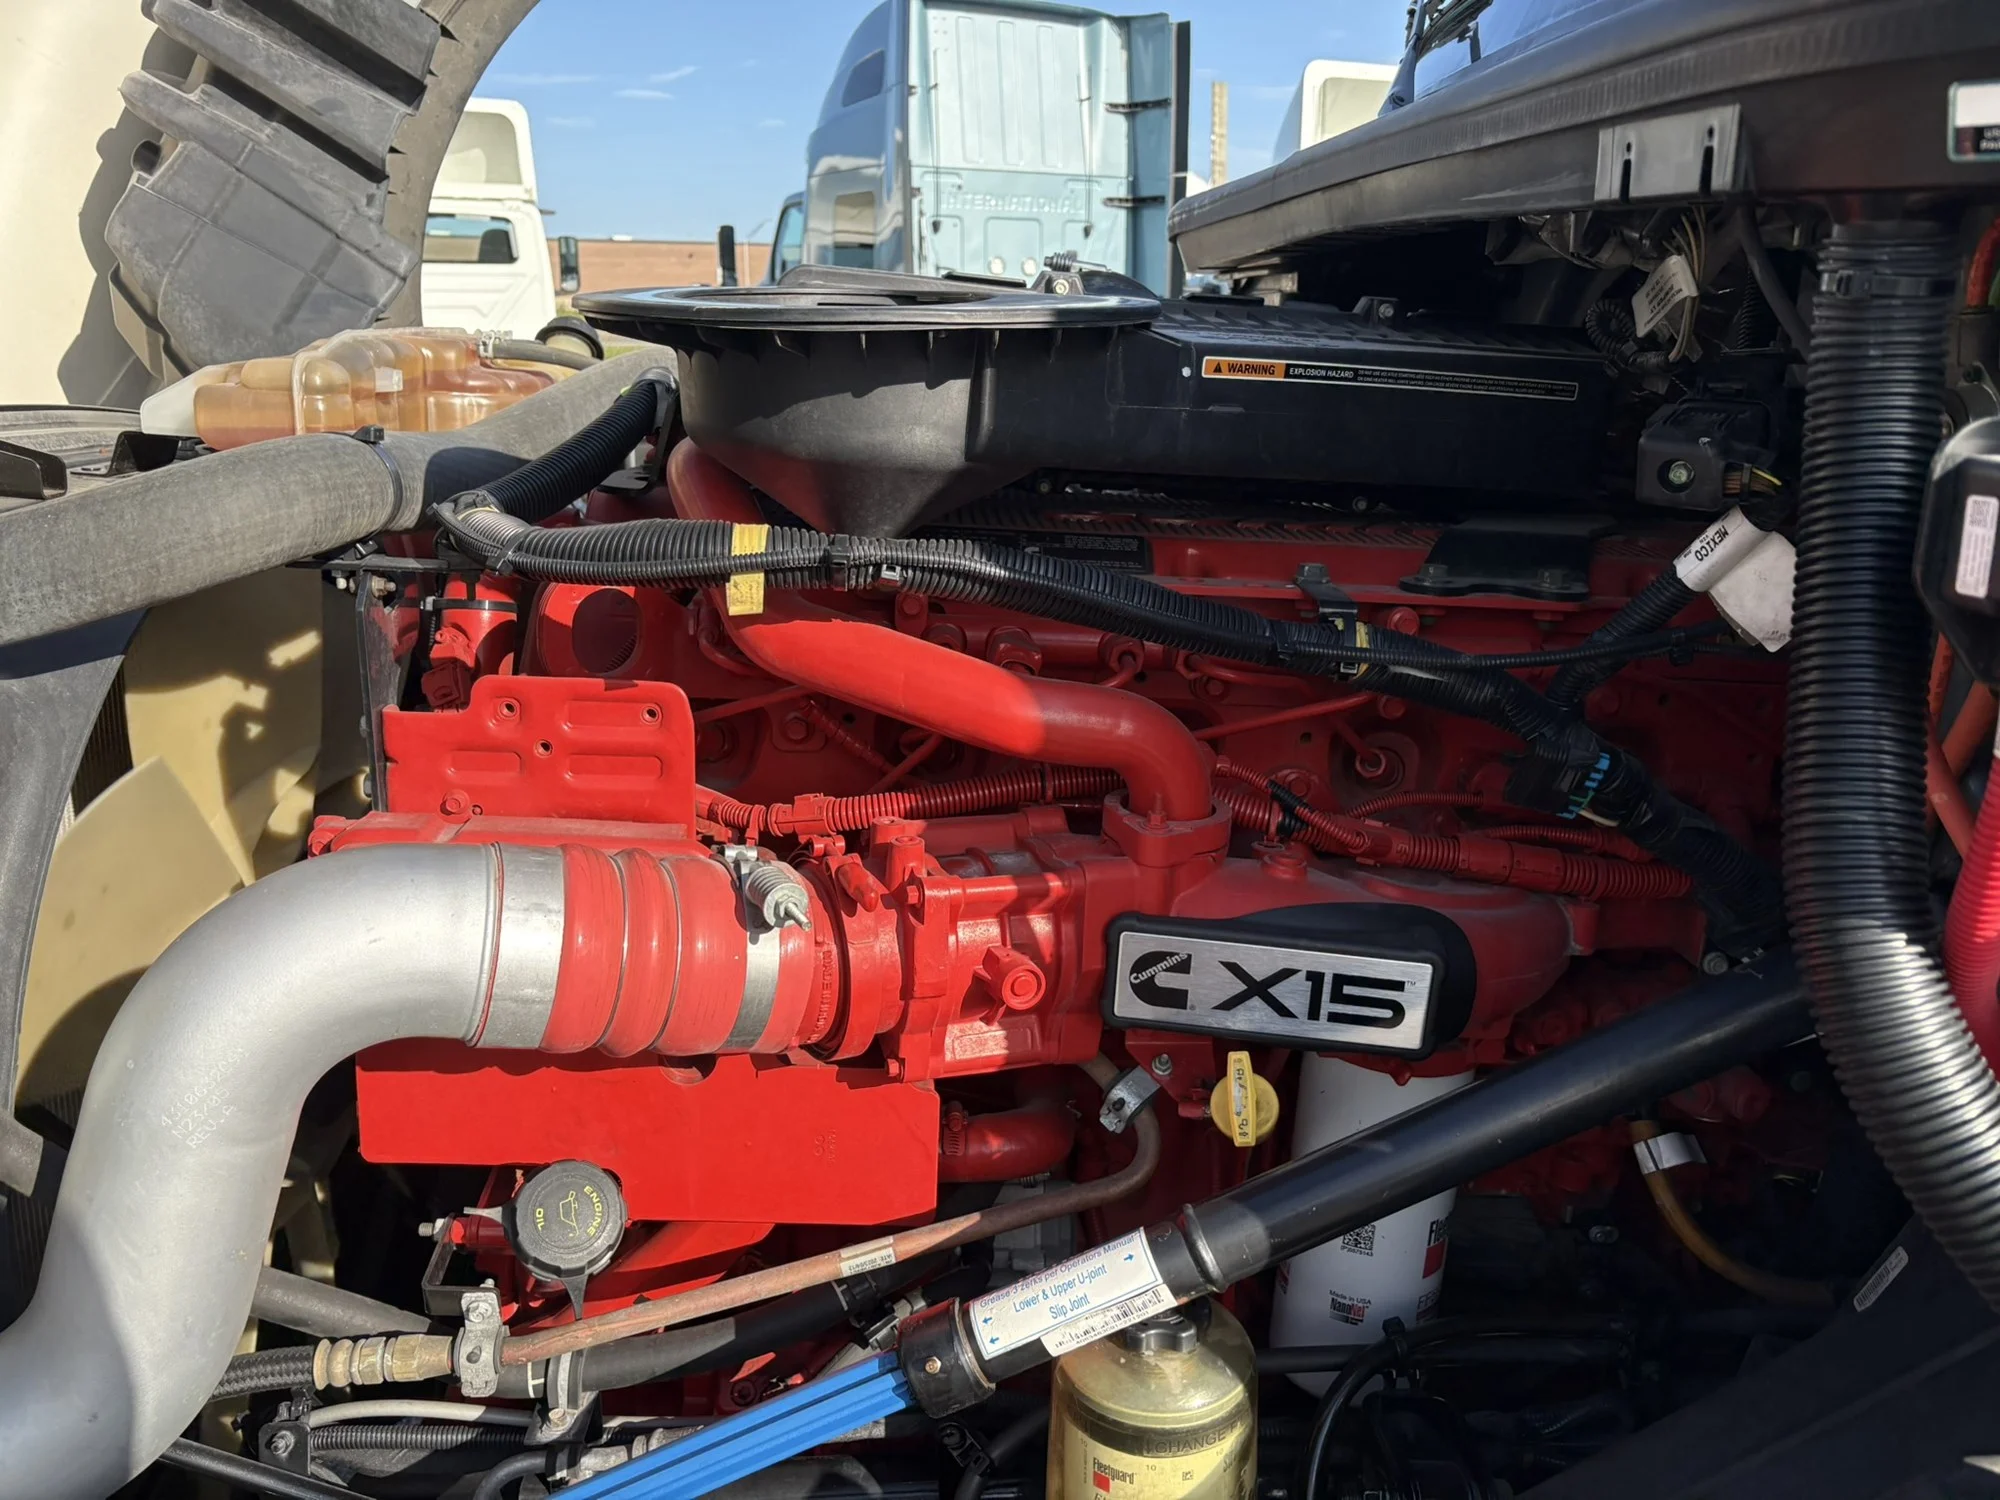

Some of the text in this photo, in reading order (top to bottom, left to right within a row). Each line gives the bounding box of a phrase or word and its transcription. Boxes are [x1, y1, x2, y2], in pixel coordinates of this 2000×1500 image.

[1227, 362, 1276, 376] WARNING
[1289, 367, 1355, 379] EXPLOSION HAZARD
[1694, 524, 1730, 562] MEXICO
[1129, 952, 1406, 1029] Cummins X15
[535, 1208, 545, 1231] OIL
[583, 1185, 603, 1237] ENGINE
[980, 1288, 1011, 1308] Grease
[1012, 1284, 1020, 1296] 3
[1043, 1268, 1059, 1284] per
[1060, 1250, 1102, 1274] Operators
[1103, 1235, 1136, 1256] Manual
[1013, 1263, 1107, 1313] Lower & Upper U-joint
[1329, 1289, 1372, 1306] Made in USA
[1048, 1301, 1068, 1320] Slip
[1068, 1292, 1091, 1313] Joint
[1330, 1297, 1365, 1318] NanoNet
[1154, 1429, 1226, 1454] CHANGE
[1093, 1457, 1135, 1485] Fleetguard
[1145, 1464, 1157, 1472] 10
